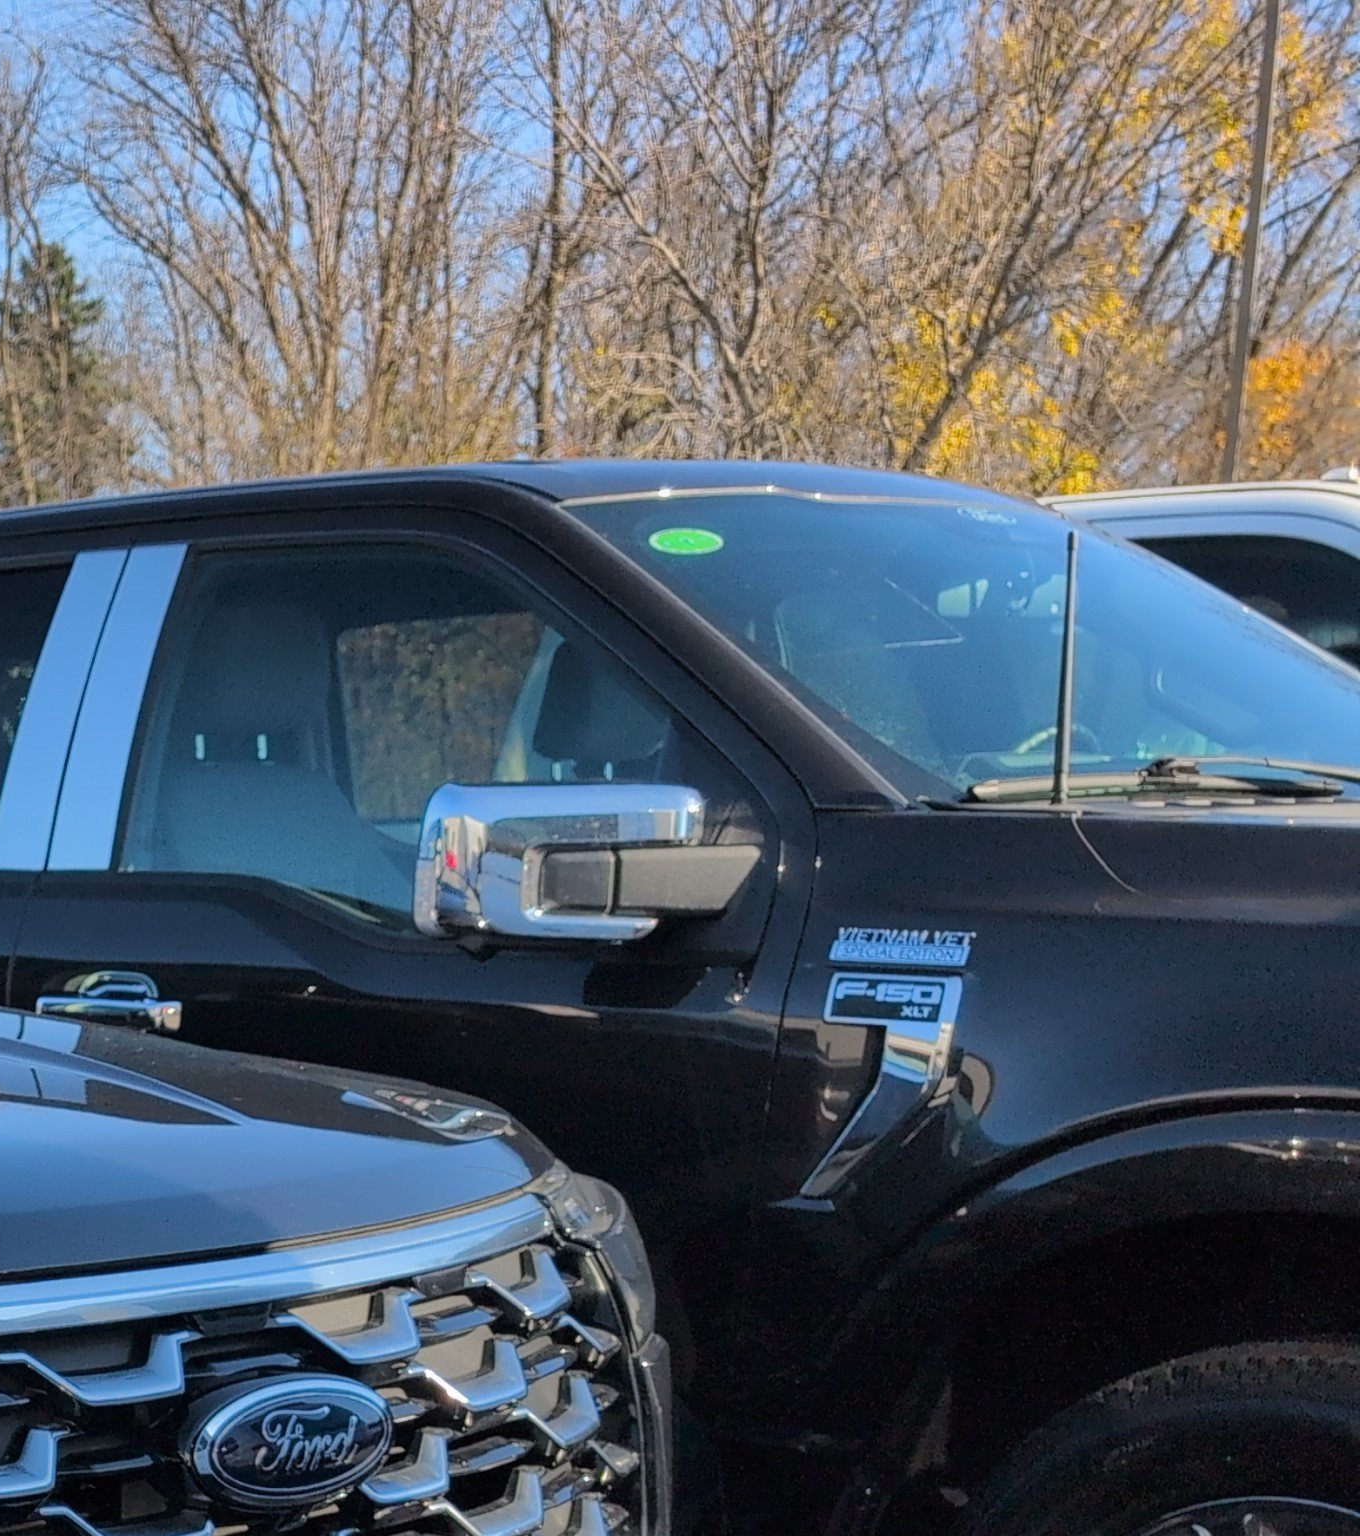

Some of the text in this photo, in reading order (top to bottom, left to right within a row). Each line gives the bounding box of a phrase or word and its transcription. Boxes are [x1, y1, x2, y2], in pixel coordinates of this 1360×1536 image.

[839, 927, 977, 947] VIETNAM VET
[835, 980, 943, 1005] F-150
[900, 1005, 932, 1018] XLT
[254, 1404, 359, 1472] Ford
